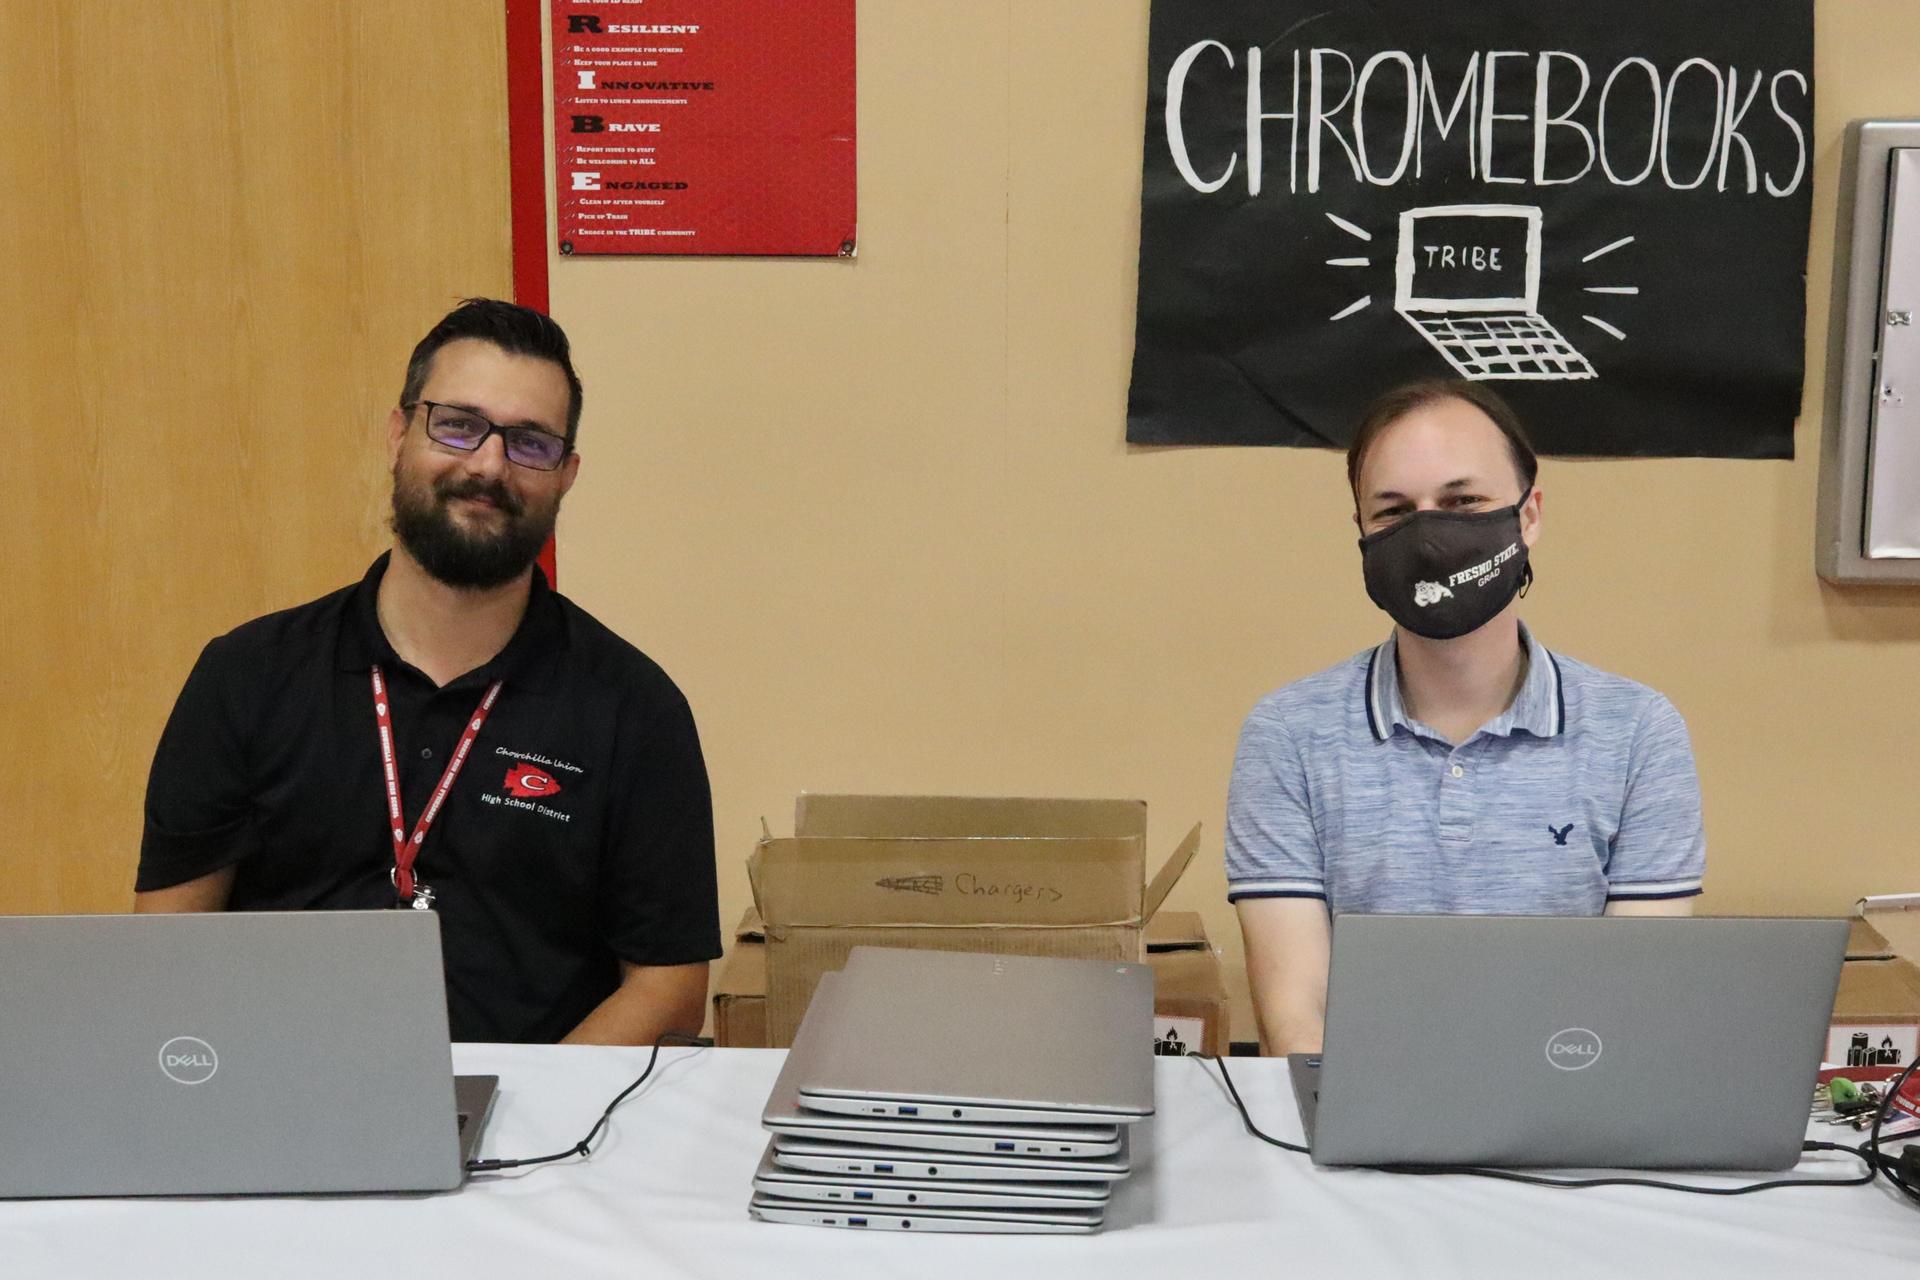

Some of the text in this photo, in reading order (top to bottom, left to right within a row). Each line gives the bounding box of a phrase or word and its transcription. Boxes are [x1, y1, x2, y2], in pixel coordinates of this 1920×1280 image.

[1166, 40, 1807, 197] CHROMEBOOKS
[1424, 245, 1502, 272] TRIBE
[1449, 542, 1519, 587] FRESNO STATE
[1478, 568, 1500, 587] GRAD
[495, 746, 584, 773] Chowchilla Union
[520, 774, 548, 791] C
[481, 793, 571, 823] High School District
[955, 872, 1064, 904] Chargers
[166, 1054, 213, 1067] DELL
[1552, 1043, 1596, 1055] DELL
